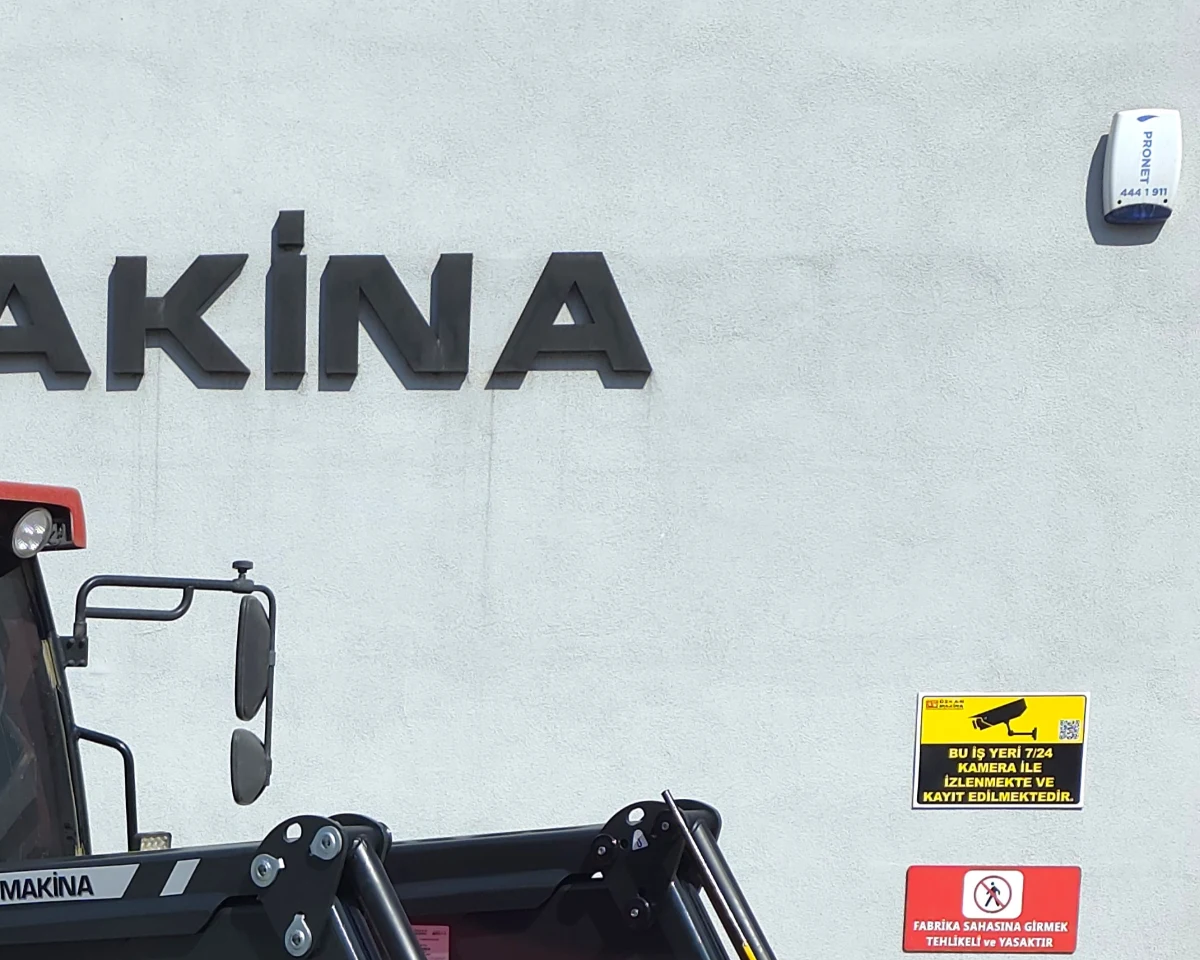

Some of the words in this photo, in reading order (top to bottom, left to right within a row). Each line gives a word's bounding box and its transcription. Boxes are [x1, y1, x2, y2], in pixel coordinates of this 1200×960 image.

[1139, 131, 1153, 185] PRONET
[1120, 188, 1141, 197] 444
[1152, 187, 1168, 196] 911
[948, 748, 968, 759] BU
[972, 745, 986, 761] İŞ
[989, 745, 1021, 759] YERİ
[1025, 747, 1053, 759] 7/24
[958, 762, 1017, 773] KAMERA
[1020, 760, 1042, 773] İLE
[944, 774, 1032, 788] İZLENMEKTE
[1036, 777, 1054, 788] VE
[923, 791, 966, 802] KAYIT
[968, 788, 1074, 802] EDİLMEKTEDİR.
[0, 871, 94, 901] MAKİNA
[913, 919, 960, 931] FABRİKA
[963, 921, 1021, 932] SAHASINA
[1024, 919, 1068, 932] GİRMEK
[926, 934, 981, 947] TEHLİKELİ
[999, 937, 1053, 947] YASAKTIR
